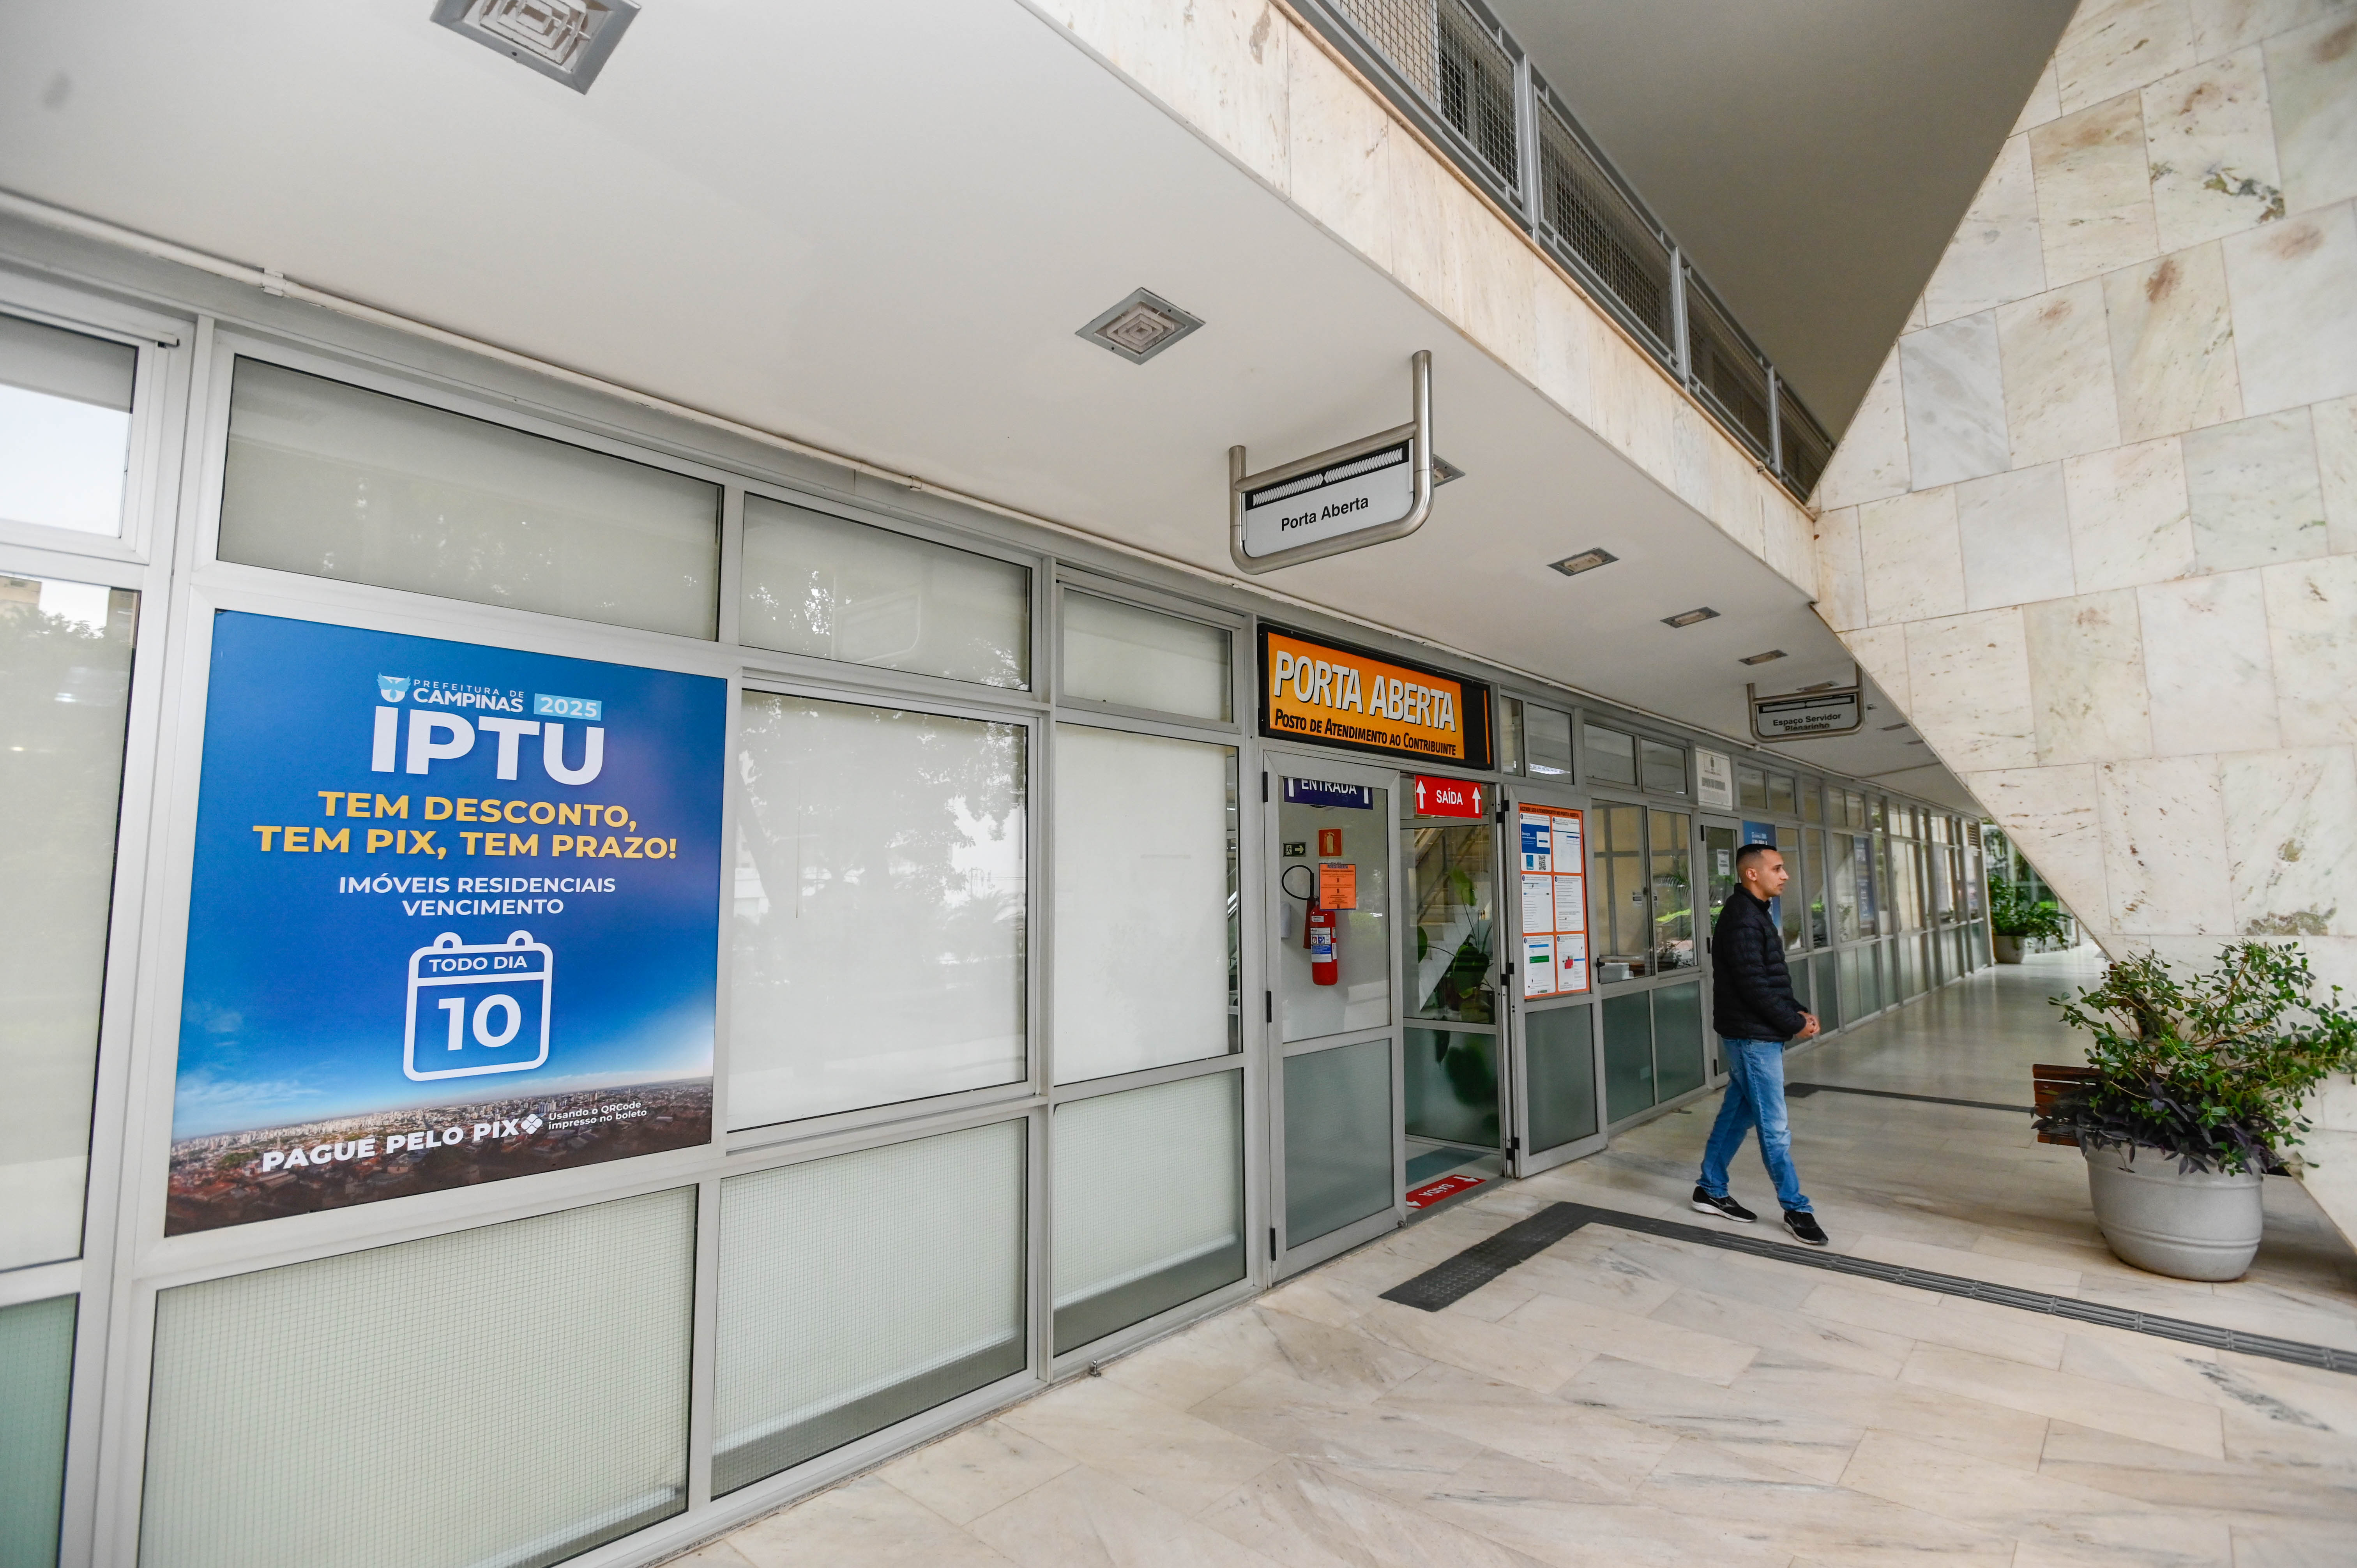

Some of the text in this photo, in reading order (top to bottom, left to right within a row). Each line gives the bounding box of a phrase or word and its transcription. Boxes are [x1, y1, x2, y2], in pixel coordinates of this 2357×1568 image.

[1281, 497, 1369, 531] Porta Aberta
[414, 680, 499, 695] PREFEITURA
[1274, 650, 1455, 732] PORTA ABERTA
[413, 688, 523, 712] CAMPINAS
[540, 697, 597, 717] 2025
[1806, 713, 1841, 722] Servidor
[1275, 708, 1456, 756] POSTO DE ATENDIMENTO AO CONTRIBUINTE
[371, 706, 604, 785] IPTU
[1302, 779, 1357, 795] ENTRADA
[1436, 788, 1463, 805] SAÍDA
[318, 791, 636, 832] TEM DESCONTO,
[253, 825, 677, 860] TEM PIX, TEM PRAZO!
[339, 873, 616, 893] IMÓVEIS RESIDENCIAIS
[402, 899, 564, 916] VENCIMENTO
[429, 956, 527, 972] TODO DIA
[438, 994, 521, 1051] 10
[548, 1117, 597, 1130] impresso
[615, 1109, 647, 1120] boleto
[549, 1109, 589, 1120] Usando
[601, 1101, 641, 1114] QRCode
[262, 1118, 520, 1172] PAGUE PELO PIX
[1419, 1184, 1454, 1196] SAÍDA
